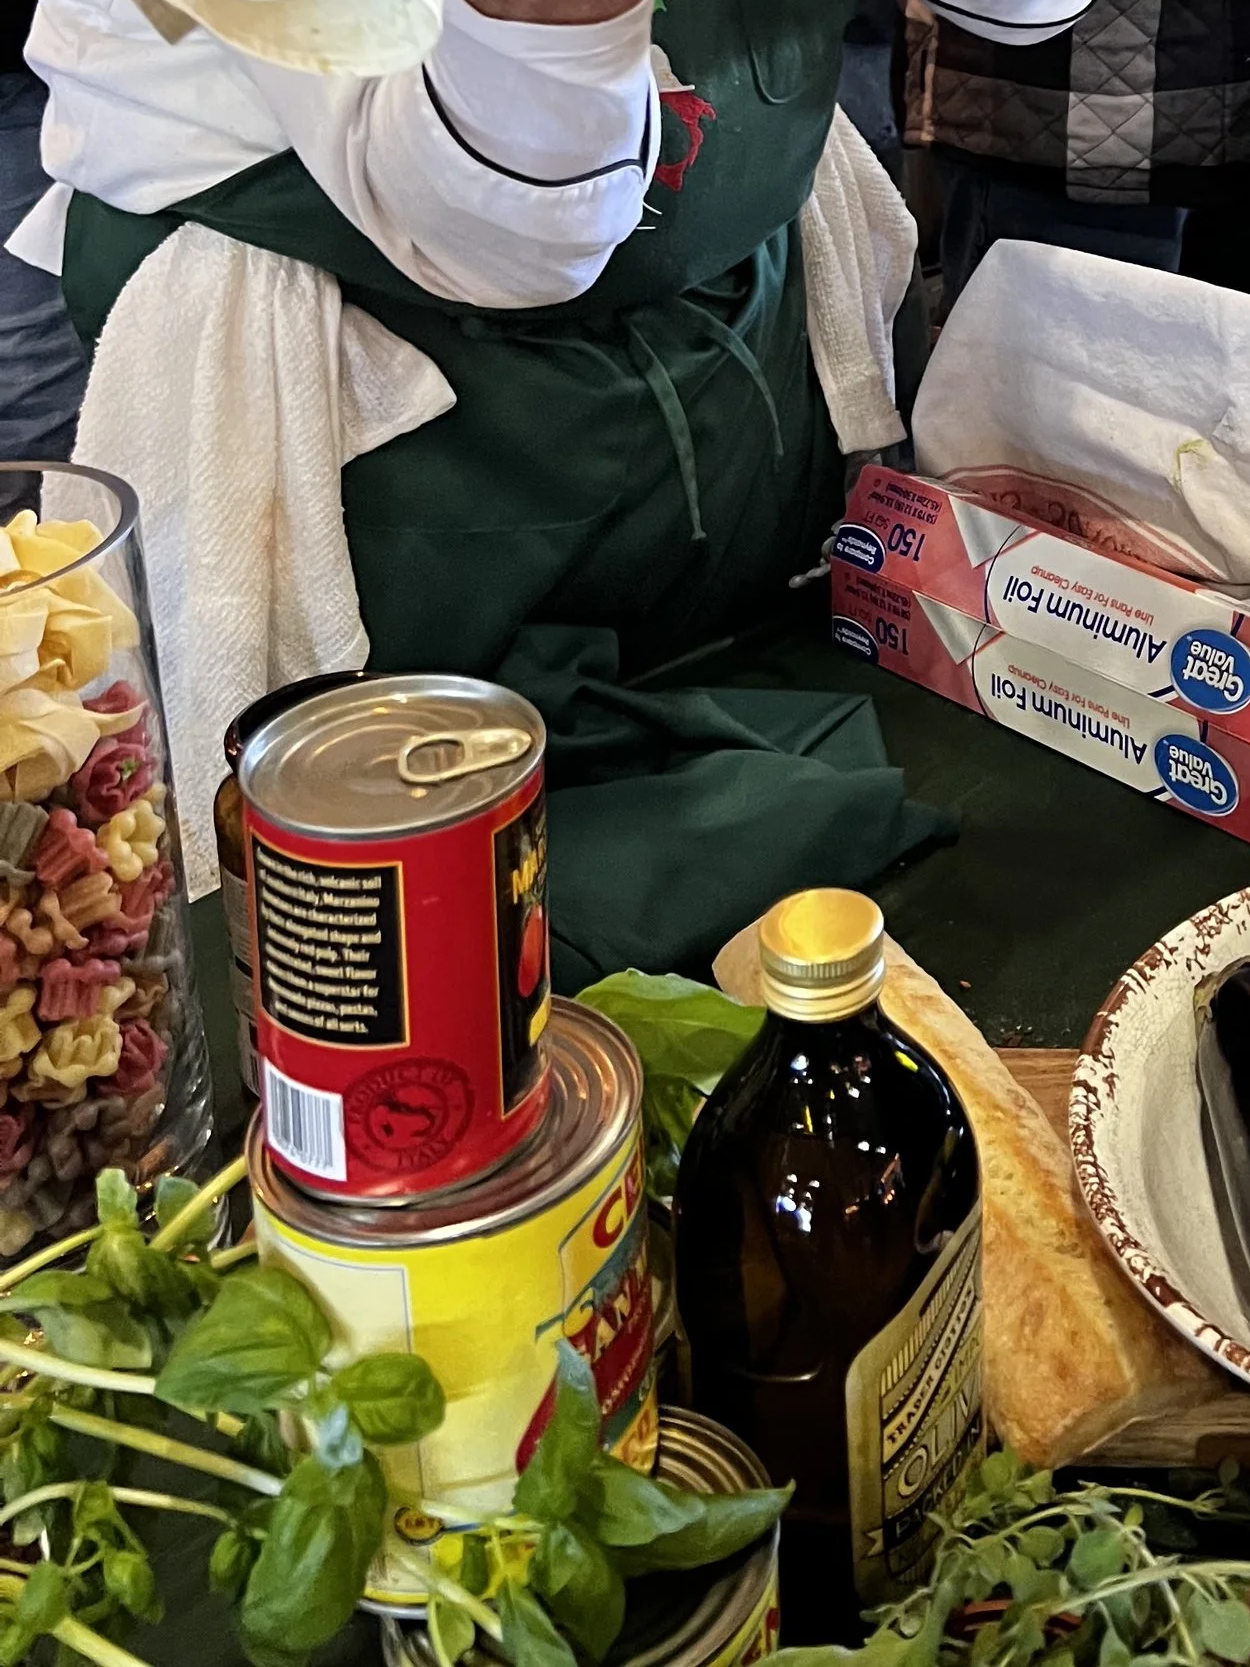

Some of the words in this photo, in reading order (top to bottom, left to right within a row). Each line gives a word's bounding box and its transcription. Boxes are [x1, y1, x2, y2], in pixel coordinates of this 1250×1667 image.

[887, 522, 926, 562] 150
[1030, 565, 1071, 590] Cleanup
[1003, 575, 1046, 614] Foil
[1070, 582, 1093, 602] Easy
[1093, 592, 1110, 608] For
[1110, 598, 1133, 618] Pans
[1133, 608, 1156, 627] Line
[875, 617, 909, 656] 150
[1046, 595, 1168, 664] Aluminum
[1190, 639, 1236, 675] Value
[1008, 664, 1046, 691] Cleanup
[1183, 654, 1244, 703] Great
[992, 673, 1027, 711] Foil
[1049, 681, 1069, 701] Easy
[1071, 693, 1086, 708] For
[1088, 699, 1109, 718] Pans
[1032, 691, 1147, 765] Aluminum
[1112, 711, 1130, 729] Line
[1169, 744, 1212, 779] Value
[1170, 759, 1228, 806] Great
[362, 875, 382, 889] soil
[330, 930, 361, 947] shape
[361, 930, 381, 944] and
[342, 948, 370, 962] Their
[363, 984, 379, 998] for
[340, 1003, 378, 1017] pastas,
[888, 1376, 934, 1445] TRADER
